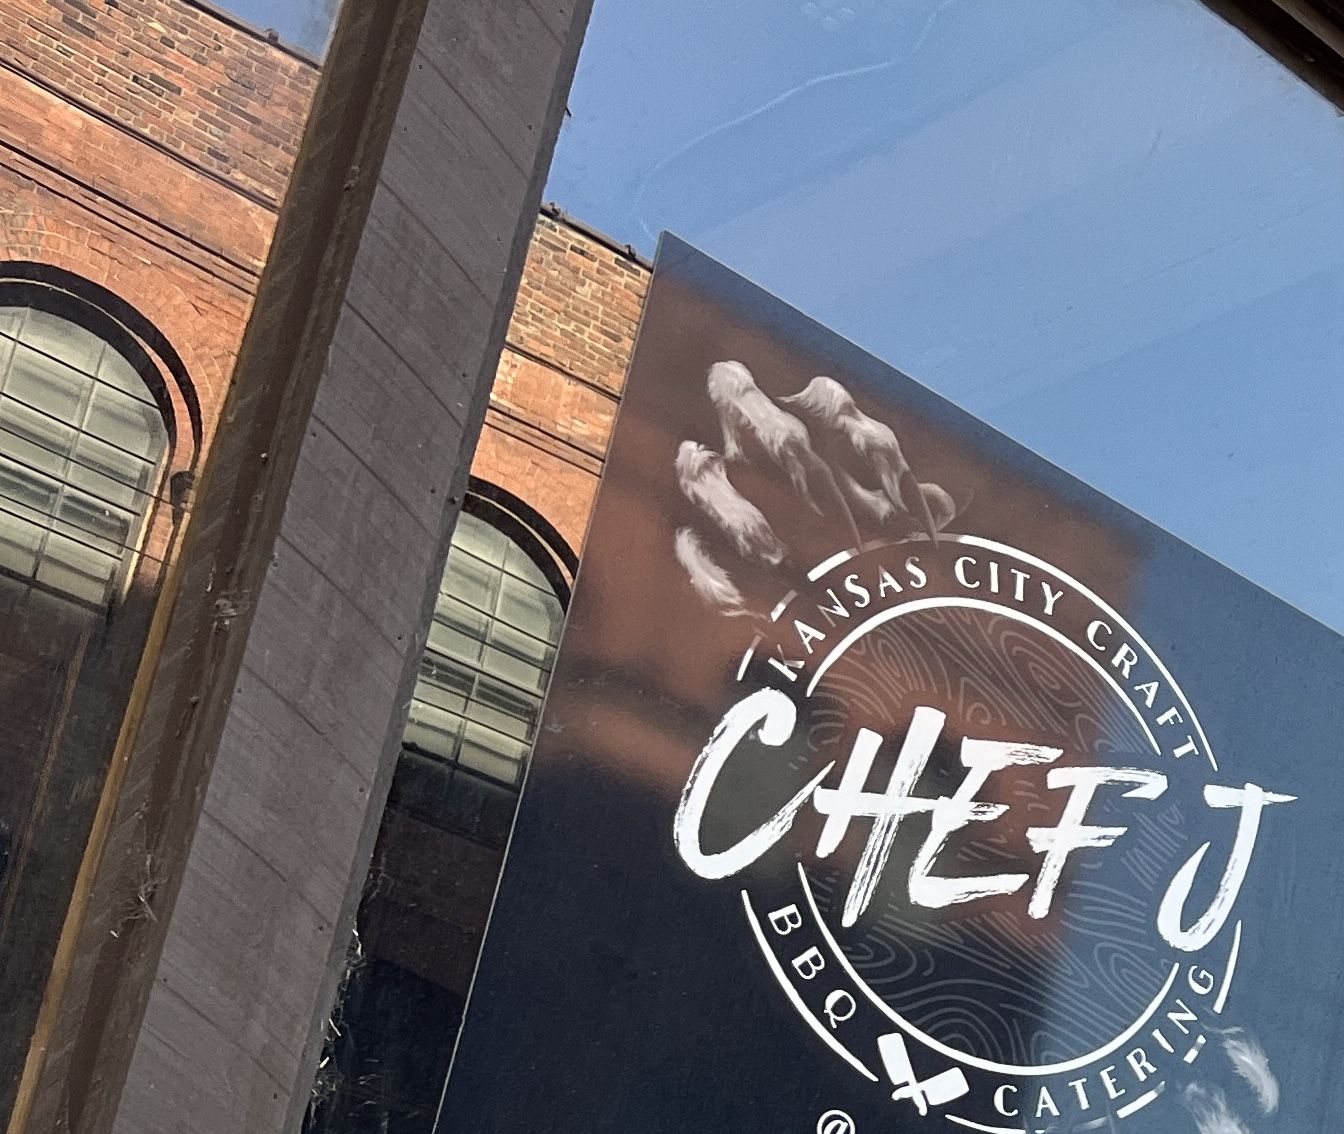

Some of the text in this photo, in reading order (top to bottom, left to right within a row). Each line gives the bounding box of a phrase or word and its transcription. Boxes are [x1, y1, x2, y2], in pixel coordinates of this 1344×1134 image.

[767, 555, 1199, 760] KANSAS CITY CRAFT
[673, 686, 1299, 953] CHEF J
[768, 903, 1214, 1118] BBQ CATERING
